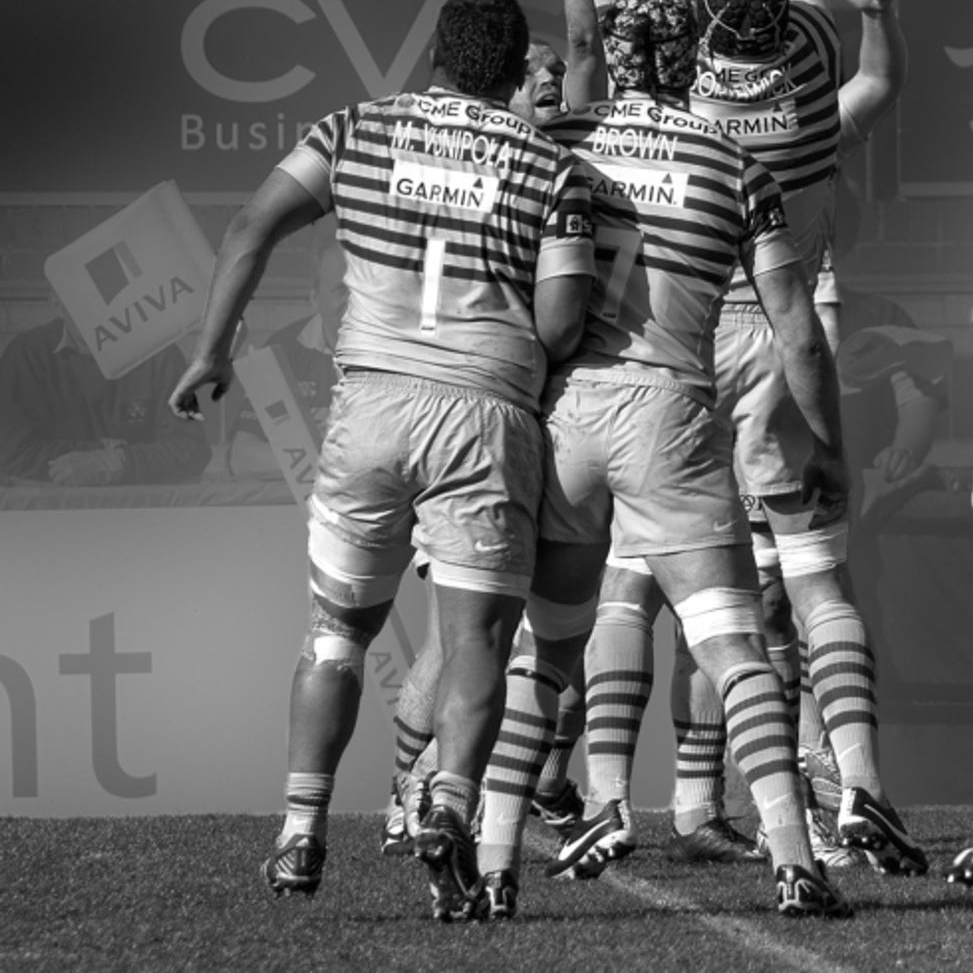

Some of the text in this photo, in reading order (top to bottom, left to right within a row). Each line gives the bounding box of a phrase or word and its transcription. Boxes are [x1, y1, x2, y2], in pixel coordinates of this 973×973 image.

[418, 99, 531, 137] CME Group
[594, 103, 643, 118] CME
[181, 114, 312, 150] Busi
[592, 126, 678, 161] BROWN
[396, 178, 485, 208] GARMIN
[421, 238, 447, 335] 1
[594, 228, 641, 325] 7
[93, 275, 194, 352] AVIVA
